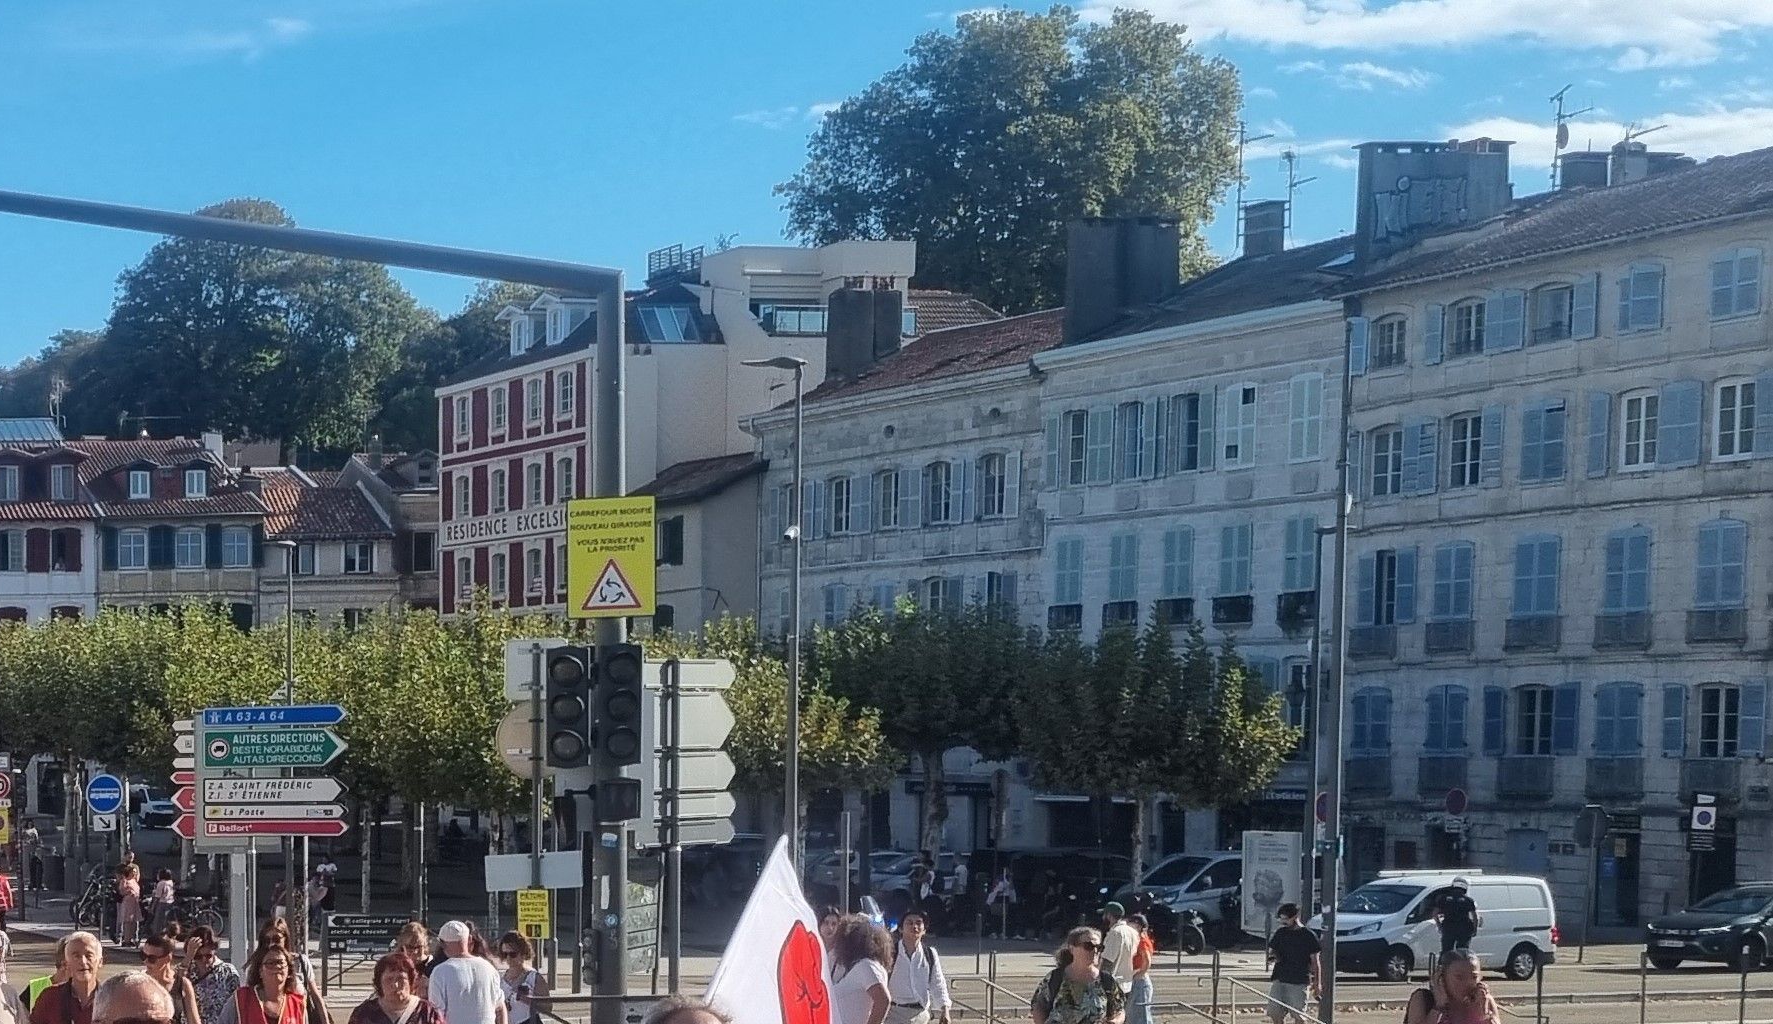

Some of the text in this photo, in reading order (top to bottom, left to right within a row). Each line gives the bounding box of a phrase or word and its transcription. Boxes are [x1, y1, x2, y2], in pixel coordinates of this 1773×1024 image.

[570, 506, 652, 518] CARREFOUR MODIFIÉ
[447, 509, 567, 541] RESIDENCE EXCELSI
[570, 521, 652, 531] NOUVEAU GIRATOIRE
[224, 712, 233, 722] A
[269, 711, 284, 721] 64
[233, 733, 325, 744] AUTRES DIRECTIONS
[233, 744, 323, 755] BESTE NORABIDEAK
[232, 754, 322, 764] AUTAS DIRECCIONS
[232, 781, 261, 790] SAINT
[223, 808, 265, 816] La Poste
